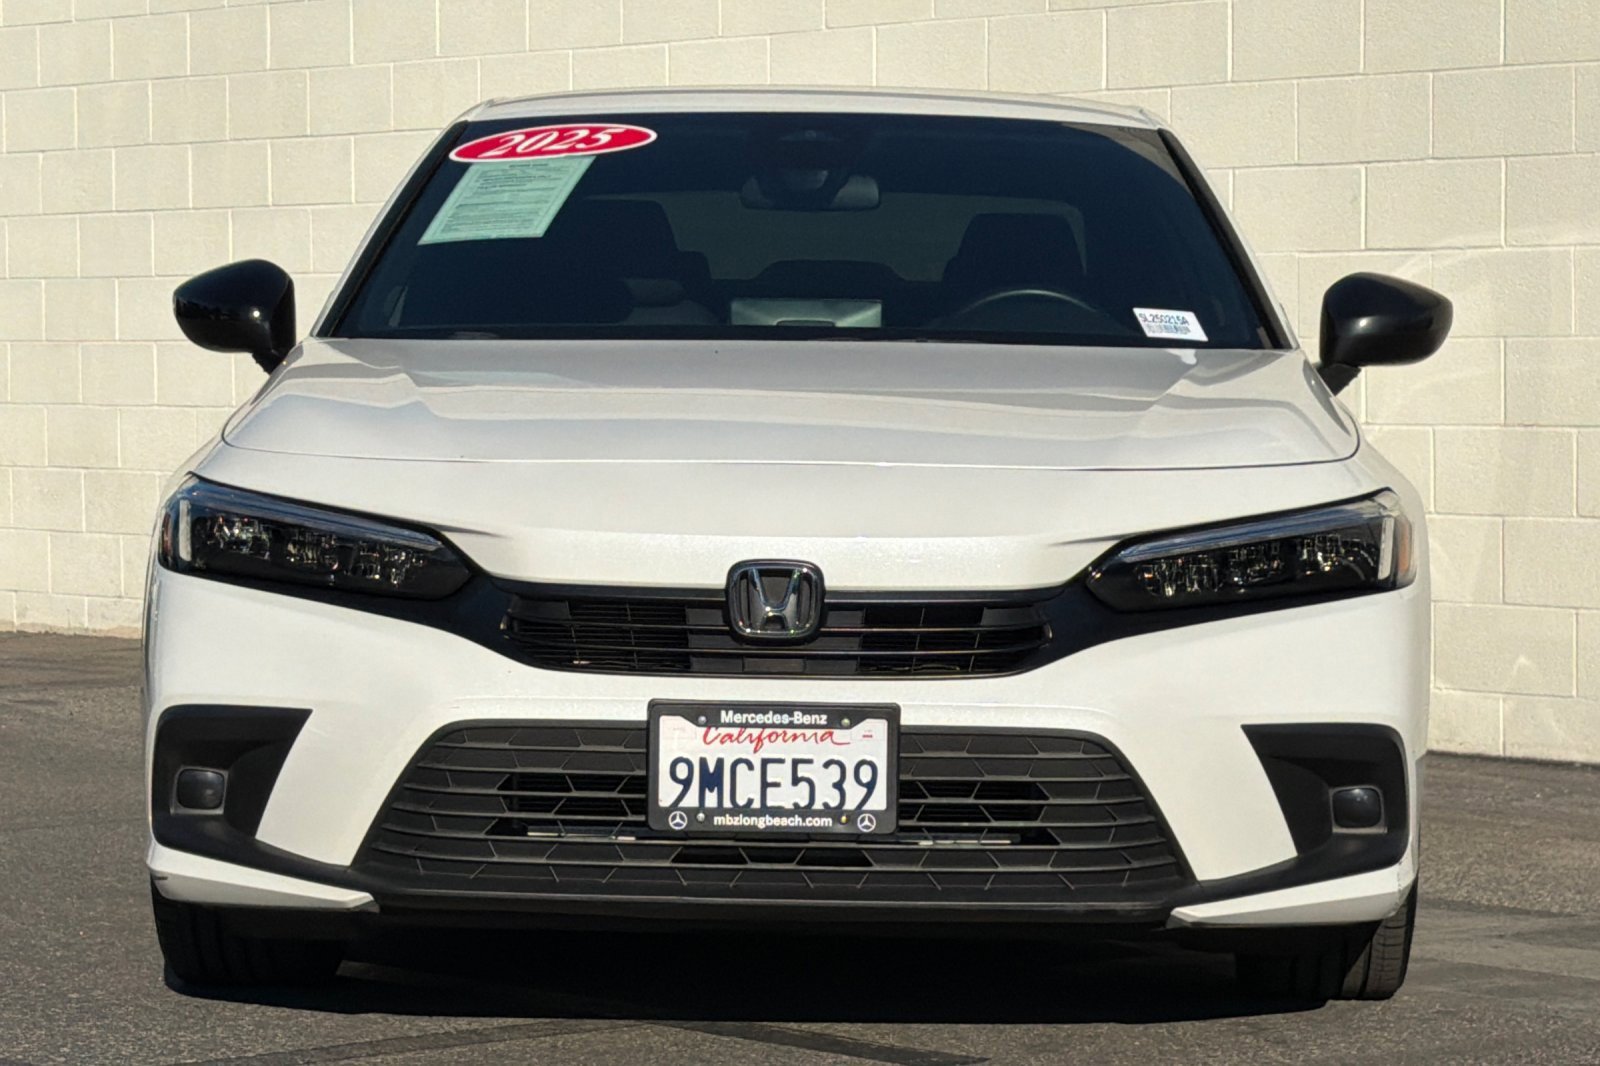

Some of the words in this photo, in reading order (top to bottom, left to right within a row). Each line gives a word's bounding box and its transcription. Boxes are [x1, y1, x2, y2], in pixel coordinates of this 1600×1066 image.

[478, 128, 627, 158] 2025
[720, 710, 828, 725] Mercedes-Benz
[703, 726, 850, 753] California
[669, 756, 878, 811] 9MCE539
[713, 813, 833, 829] mbzlongbeach.com
